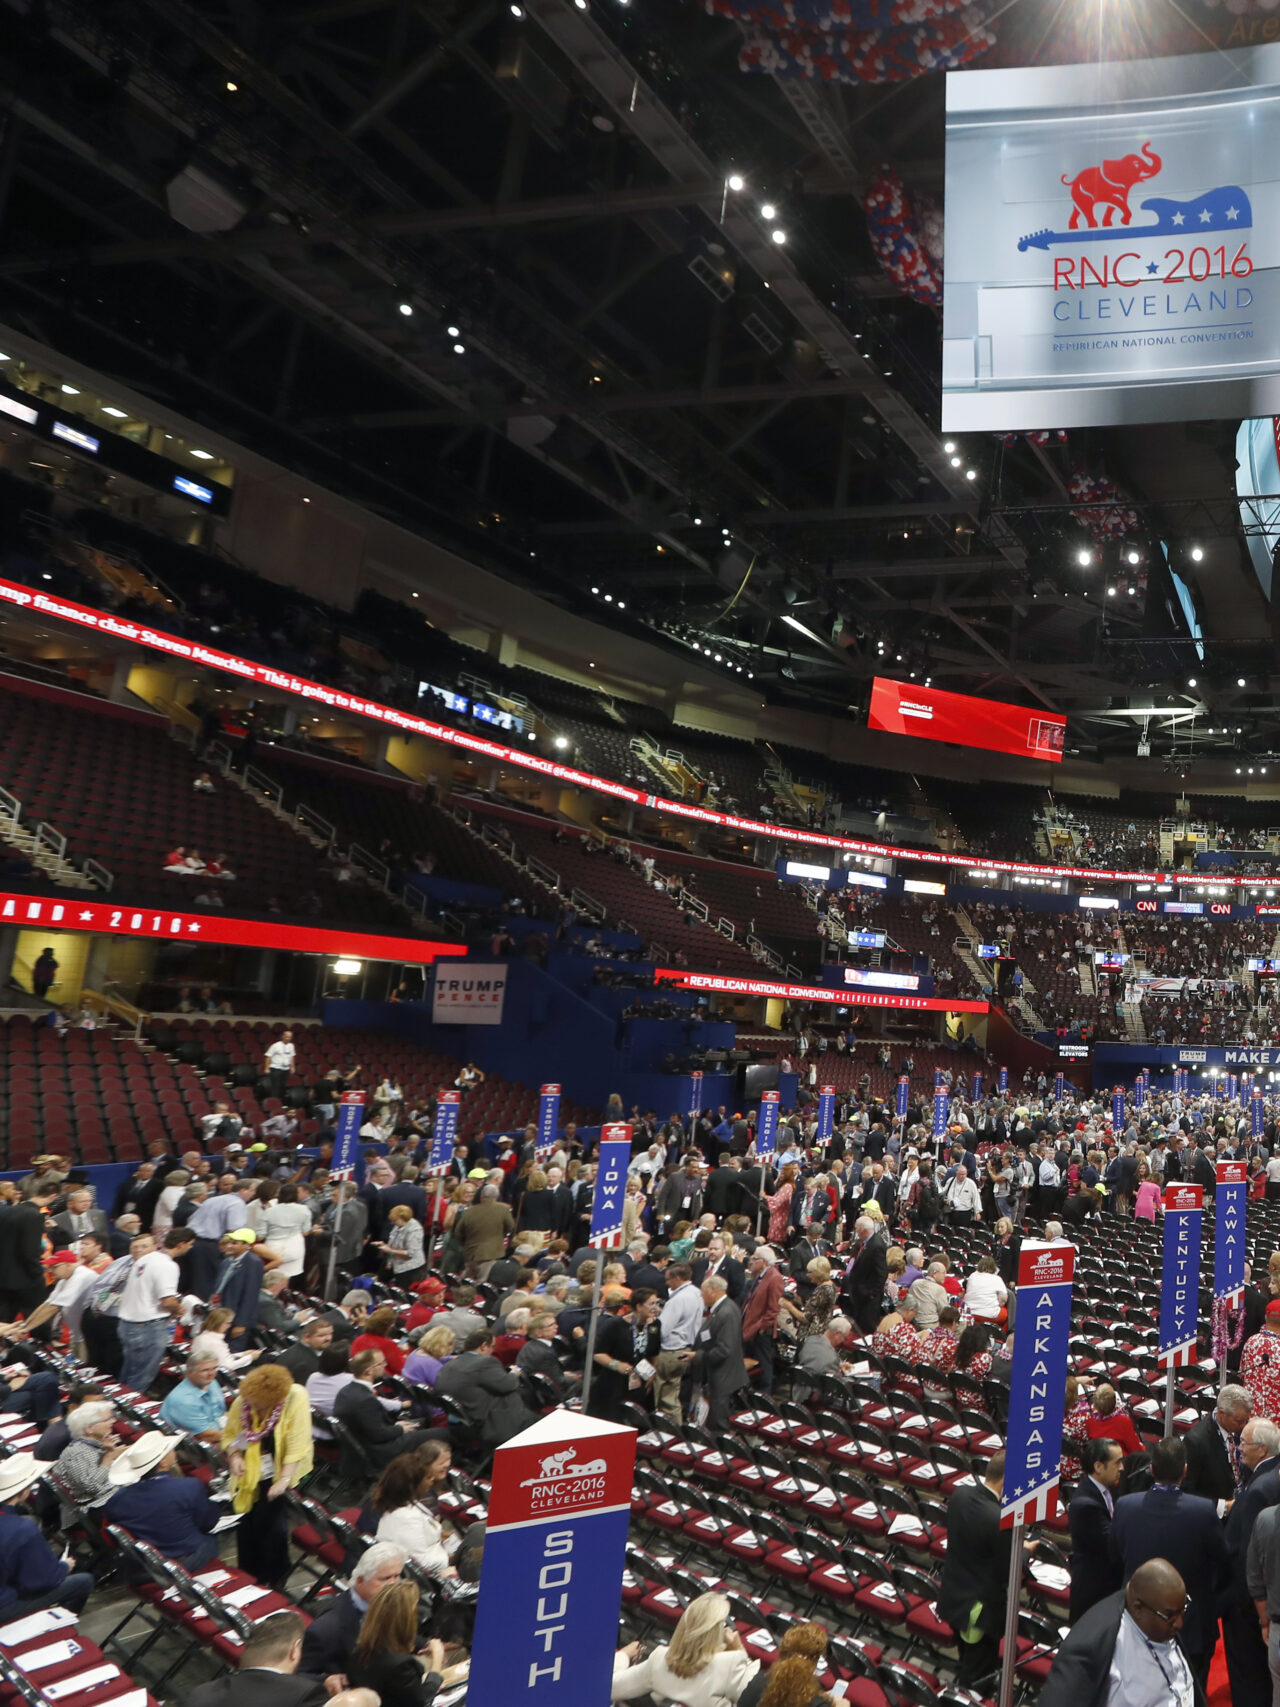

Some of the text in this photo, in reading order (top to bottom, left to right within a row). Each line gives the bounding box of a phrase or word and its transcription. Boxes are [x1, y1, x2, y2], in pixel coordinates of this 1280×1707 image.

[1162, 243, 1254, 284] 2016
[1053, 288, 1254, 321] CLEVELAND
[1053, 330, 1254, 352] REPUBLICAN NATIONAL CONVENTION
[33, 595, 98, 624] finance
[98, 618, 141, 639] chair
[140, 631, 192, 655] Steven
[302, 686, 335, 703] going
[365, 704, 383, 717] the
[740, 821, 765, 832] election
[776, 829, 798, 840] choice
[798, 832, 828, 845] between
[843, 841, 861, 850] order
[868, 845, 888, 854] safety
[922, 853, 941, 862] crime
[948, 856, 977, 866] violence.
[994, 862, 1013, 871] make
[1012, 864, 1040, 873] America
[1055, 868, 1073, 876] again
[1084, 871, 1114, 879] everyone.
[110, 912, 181, 933] 2016
[1137, 901, 1158, 911] CNN
[1211, 904, 1231, 914] CNN
[436, 980, 504, 992] TRUMP
[437, 993, 500, 1003] PENCE
[690, 975, 747, 990] REPUBLICAN
[748, 982, 788, 995] NATIONAL
[789, 987, 834, 1000] CONVENTION
[1225, 1052, 1270, 1064] MAKE
[432, 1105, 456, 1159] AMERICAN SAMOA
[543, 1097, 555, 1141] MISSOURI
[761, 1104, 773, 1147] GEORGIA
[936, 1097, 946, 1130] NEVADA
[340, 1106, 356, 1164] NORTH DAKOTA
[601, 1157, 619, 1210] IOWA
[1225, 1190, 1237, 1274] HAWAII
[1174, 1216, 1190, 1331] KENTUCKY
[1026, 1292, 1053, 1469] ARKANSAS
[531, 1490, 605, 1509] CLEVELAND
[572, 1476, 606, 1493] 2016
[528, 1530, 574, 1688] SOUTH
